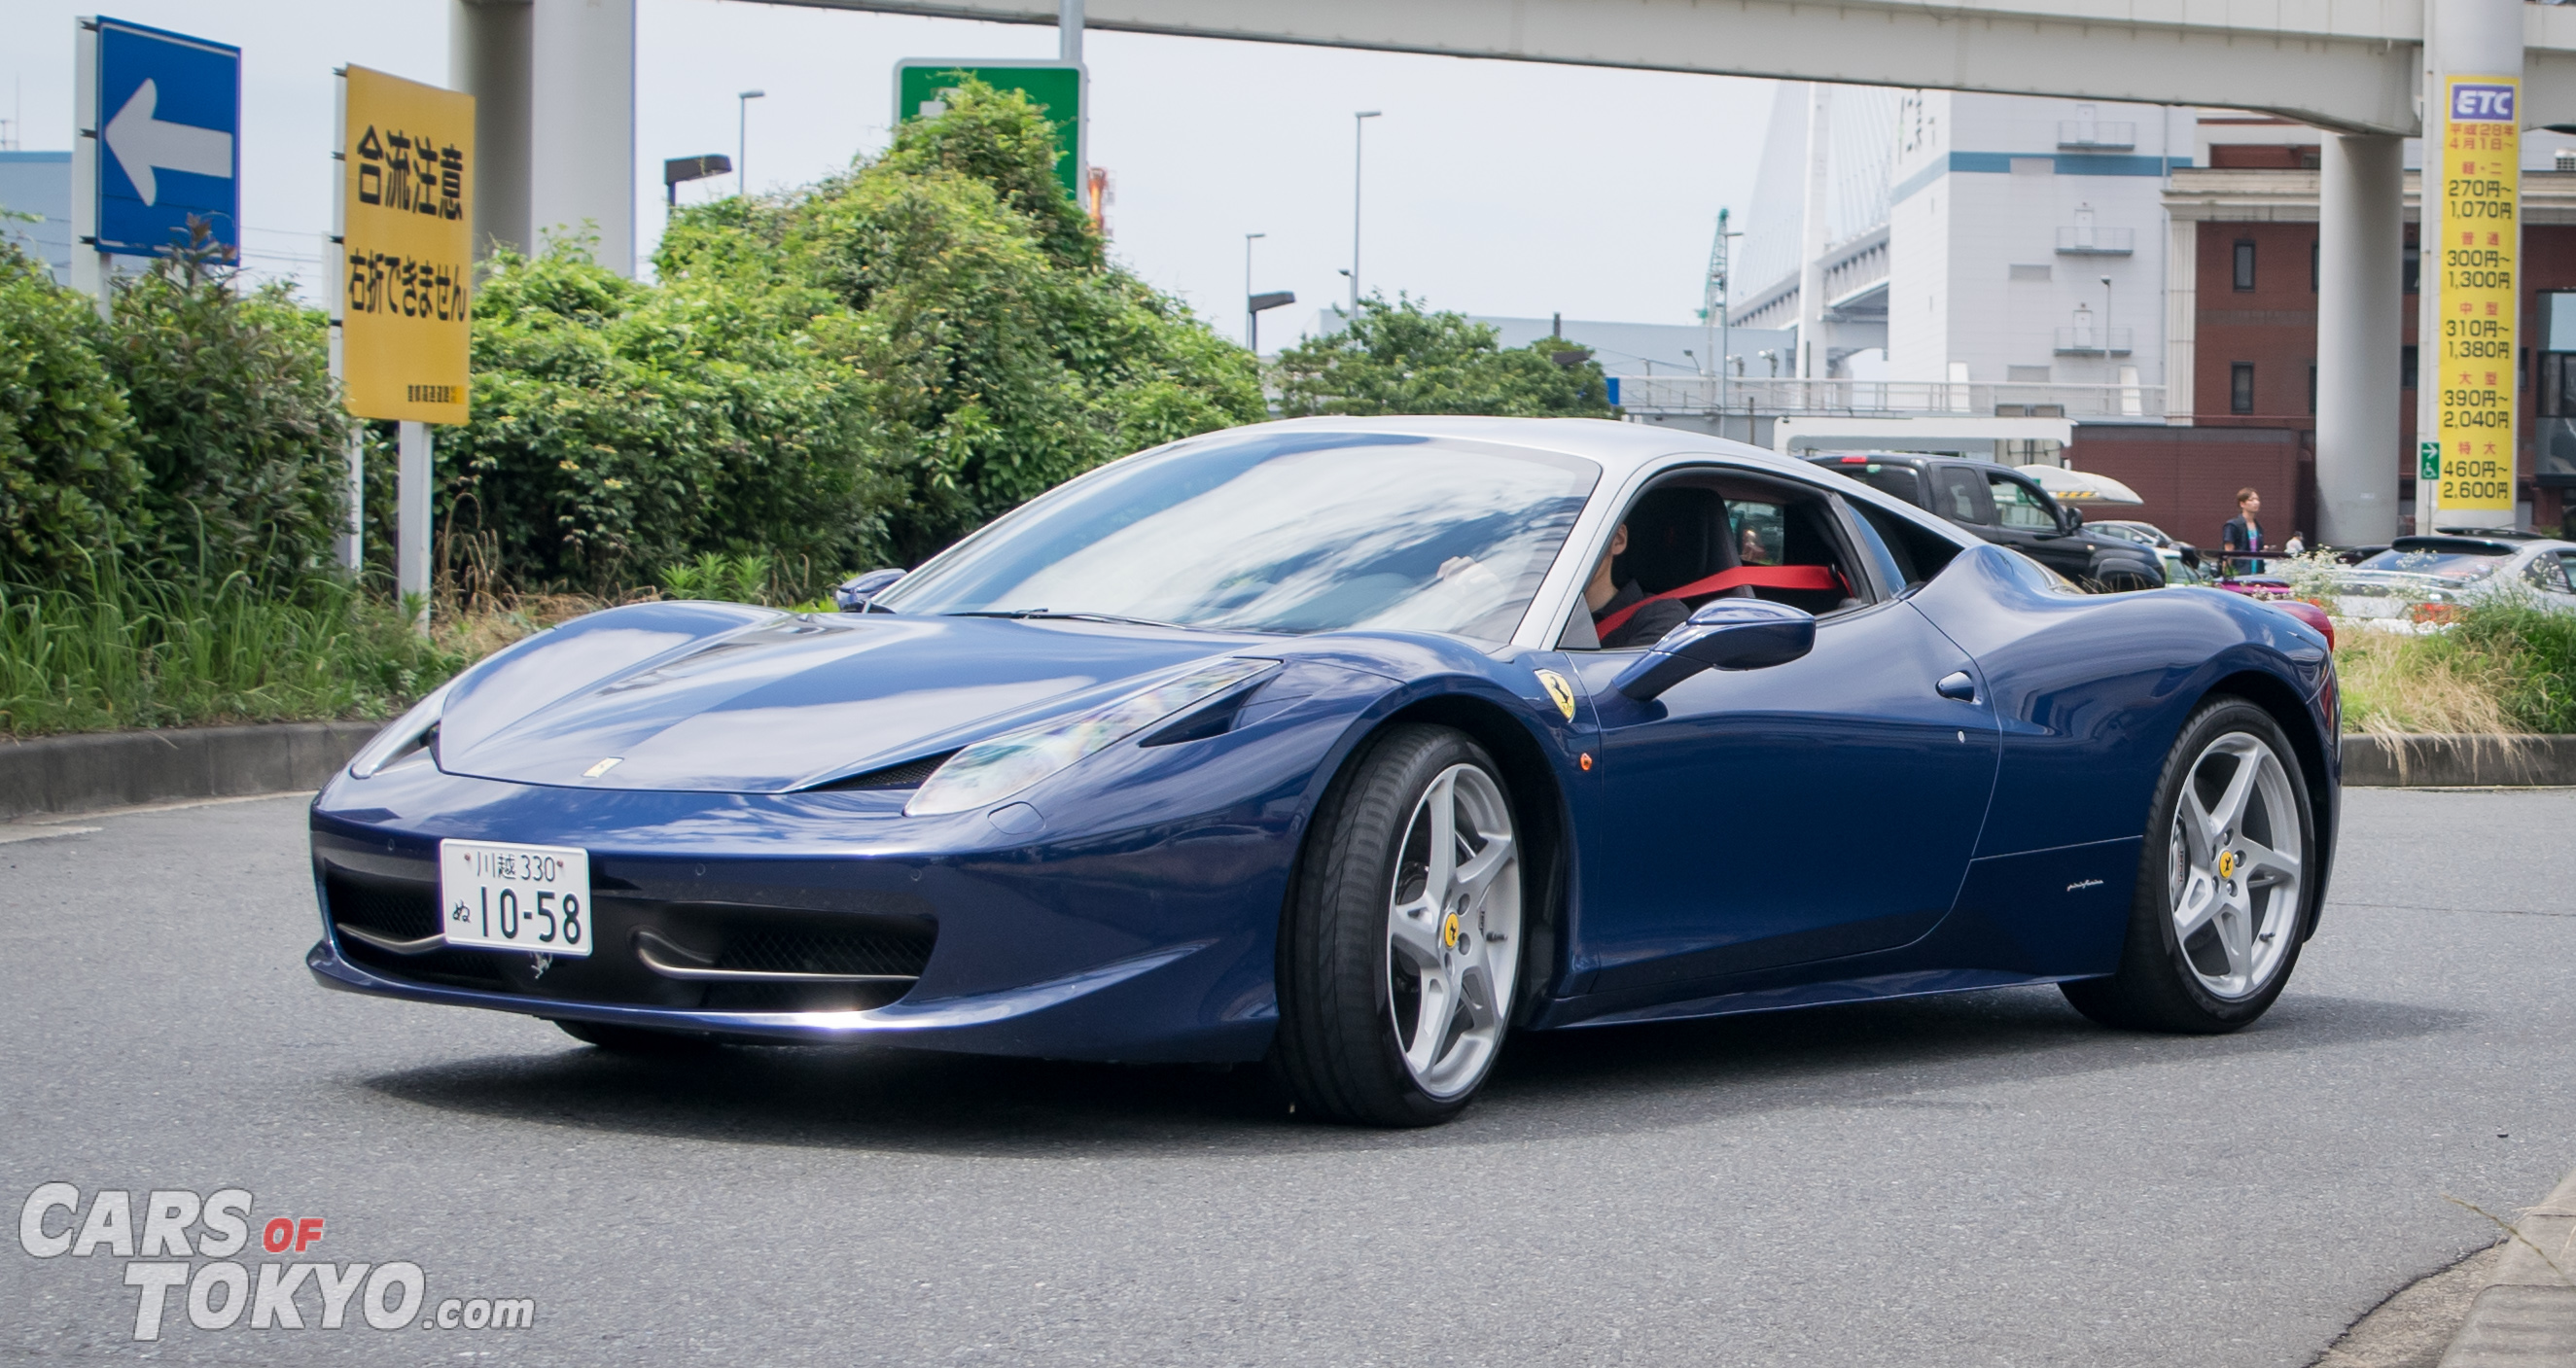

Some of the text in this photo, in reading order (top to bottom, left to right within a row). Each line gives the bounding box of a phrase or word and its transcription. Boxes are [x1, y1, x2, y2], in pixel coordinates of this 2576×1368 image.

[2456, 90, 2512, 115] ETC
[357, 124, 463, 221] 合流注意
[2450, 200, 2512, 219] 1,070円
[348, 247, 467, 322] 右折できません
[2448, 271, 2511, 289] 1,300円
[2448, 340, 2510, 359] 1,380円
[2444, 410, 2509, 429] 2,040円
[2443, 481, 2508, 499] 2,600円
[477, 851, 555, 882] 川越 330
[452, 886, 582, 945] ぬ 10-58
